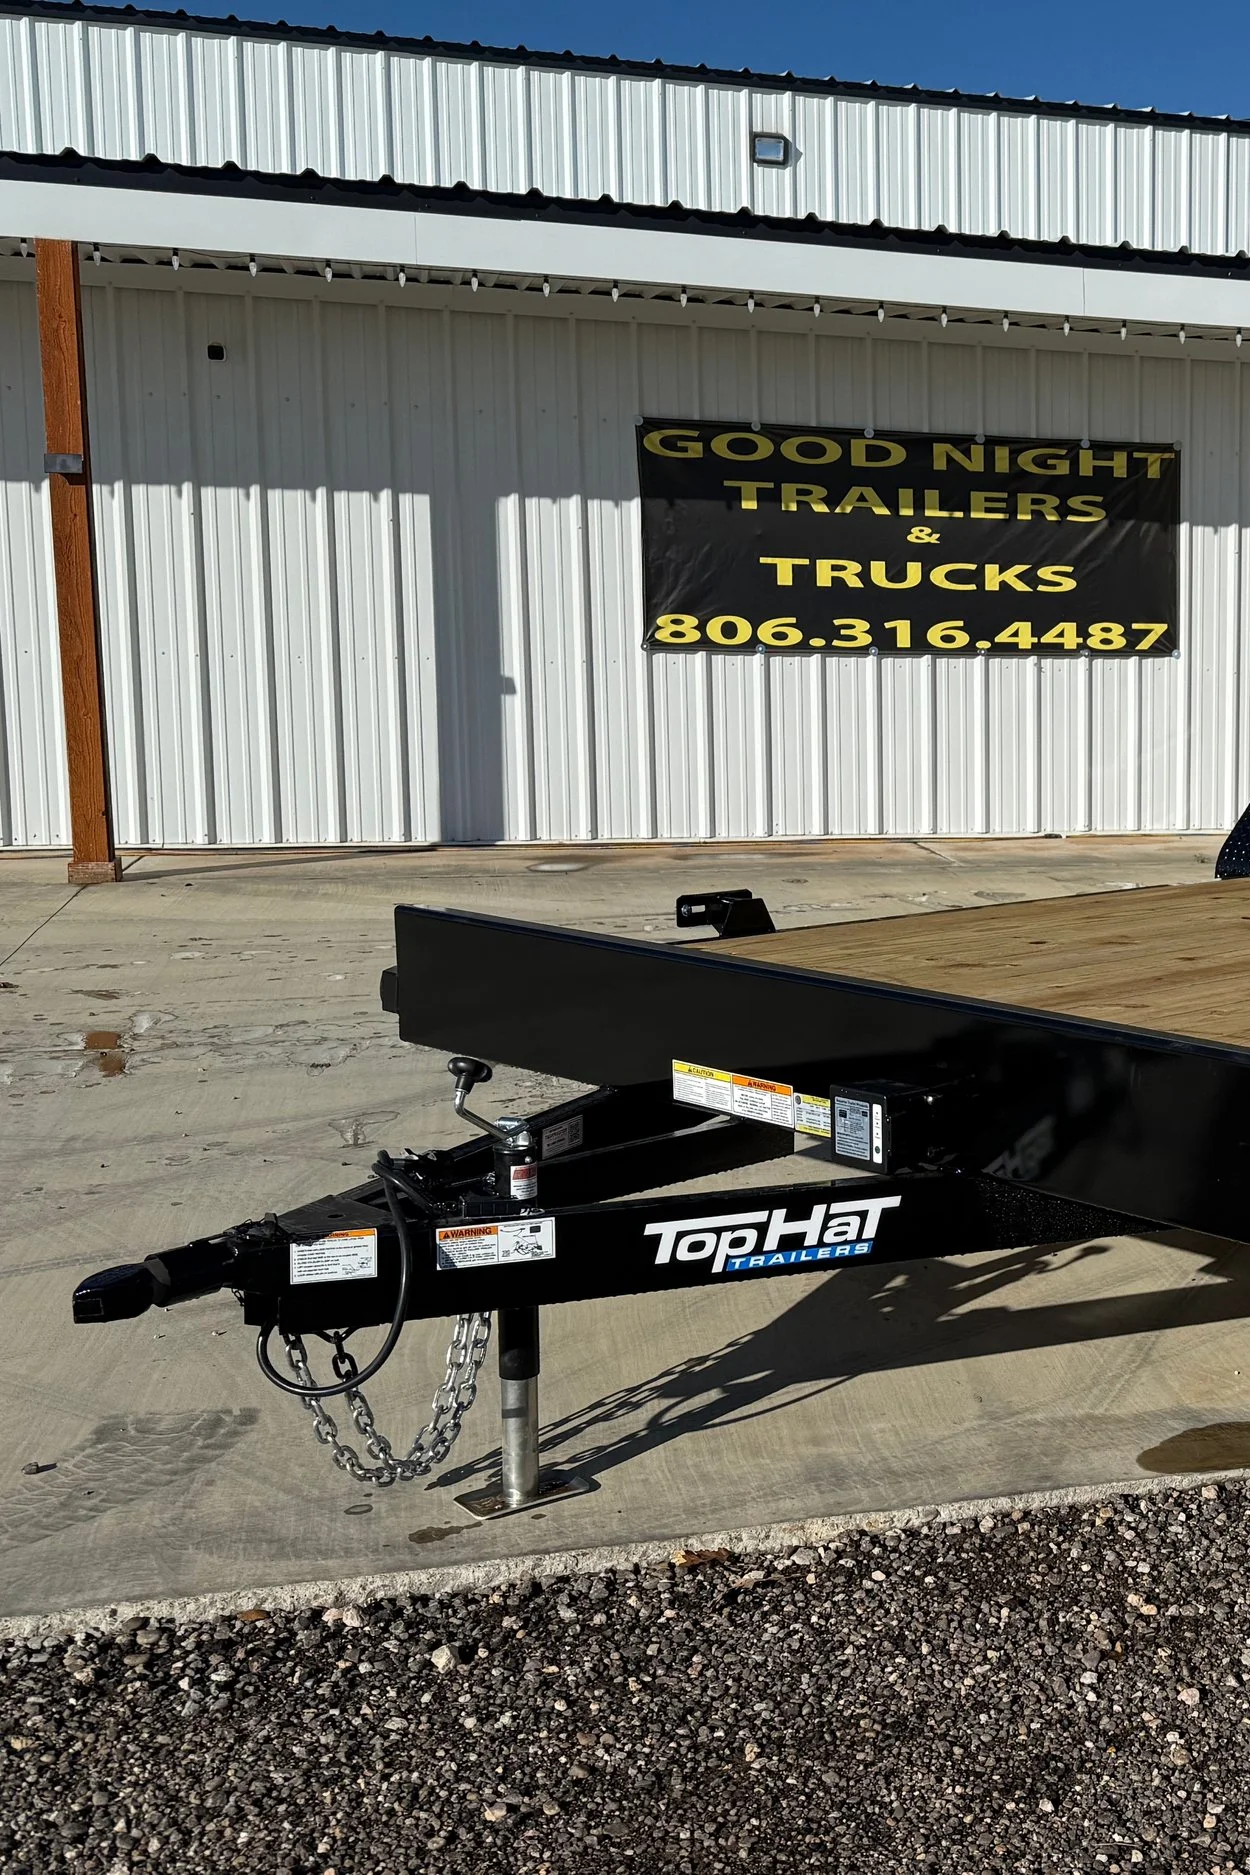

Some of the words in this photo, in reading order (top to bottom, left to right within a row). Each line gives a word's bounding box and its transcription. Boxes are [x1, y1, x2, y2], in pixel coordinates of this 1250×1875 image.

[642, 428, 907, 468] GOOD
[932, 442, 1176, 479] NIGHT
[723, 480, 1107, 523] TRAILERS
[906, 526, 940, 545] &
[759, 556, 1078, 593] TRUCKS
[654, 613, 1169, 651] 806.316.4487
[692, 1067, 715, 1078] CAUTION
[752, 1080, 777, 1092] WARNING
[450, 1227, 492, 1239] WARNING
[729, 1242, 871, 1270] TRAILERS
